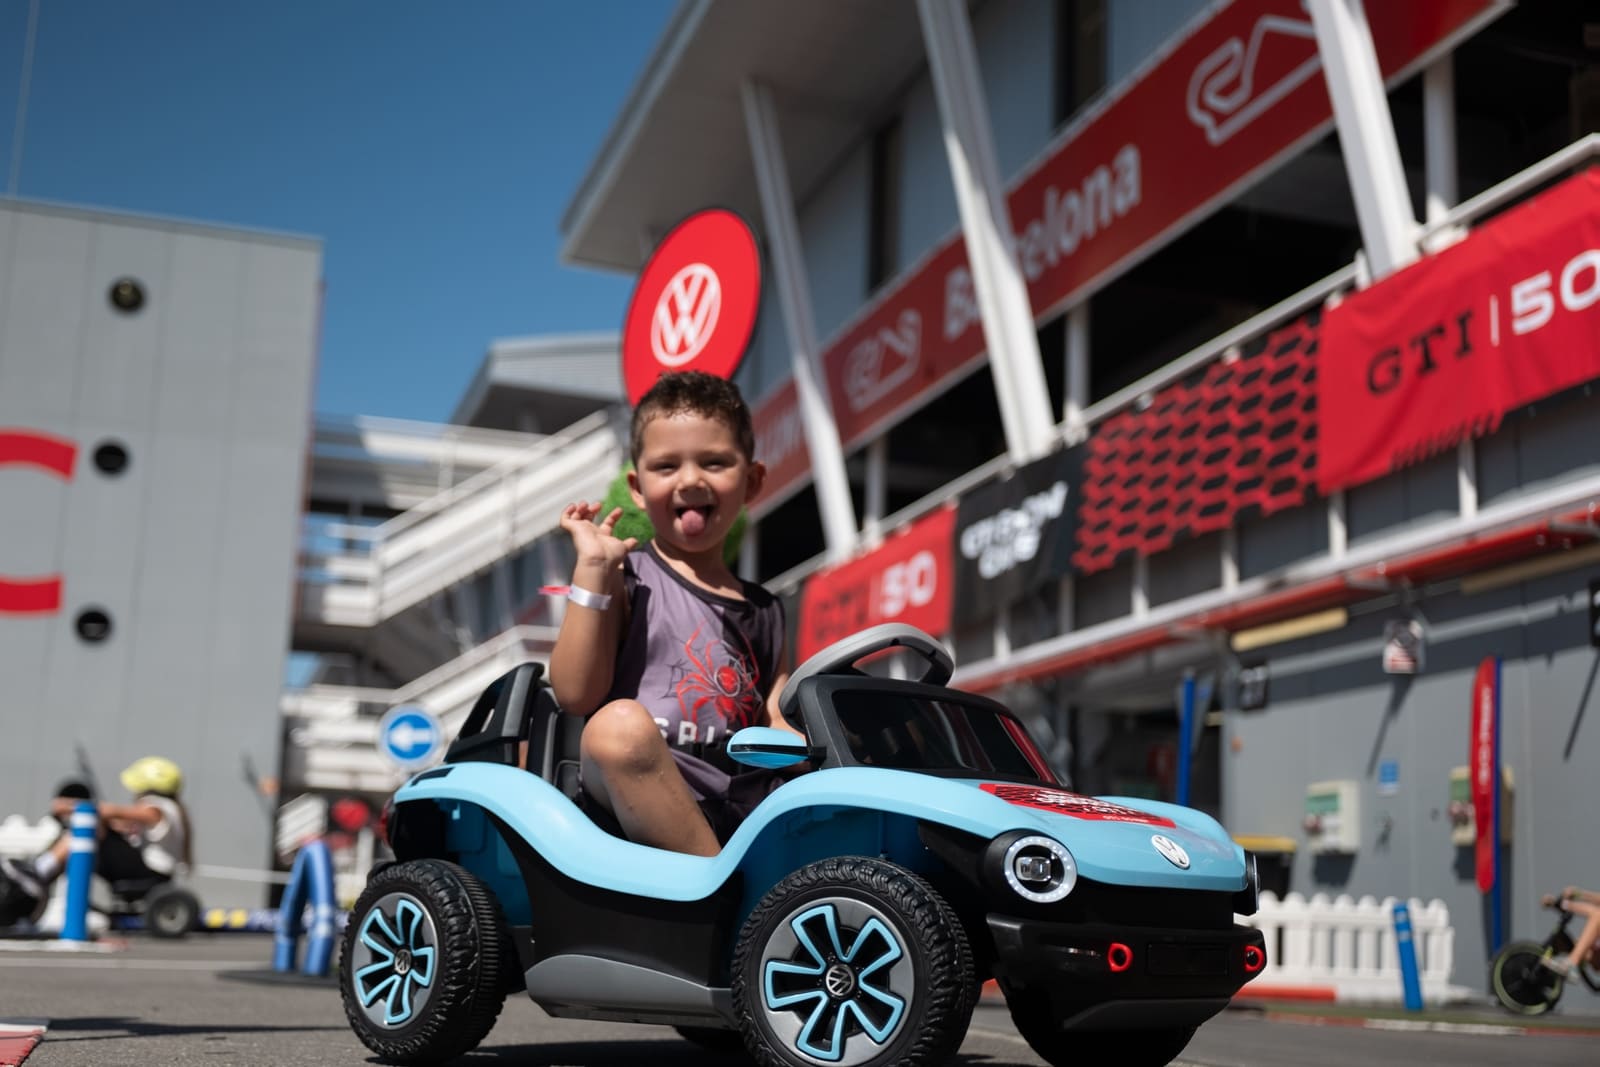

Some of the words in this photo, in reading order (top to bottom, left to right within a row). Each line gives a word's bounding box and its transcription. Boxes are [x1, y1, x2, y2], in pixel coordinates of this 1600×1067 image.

[944, 144, 1142, 340] Belona
[652, 264, 720, 364] VW
[1366, 308, 1474, 395] GTI
[1510, 248, 1600, 336] 50
[880, 550, 937, 618] 50
